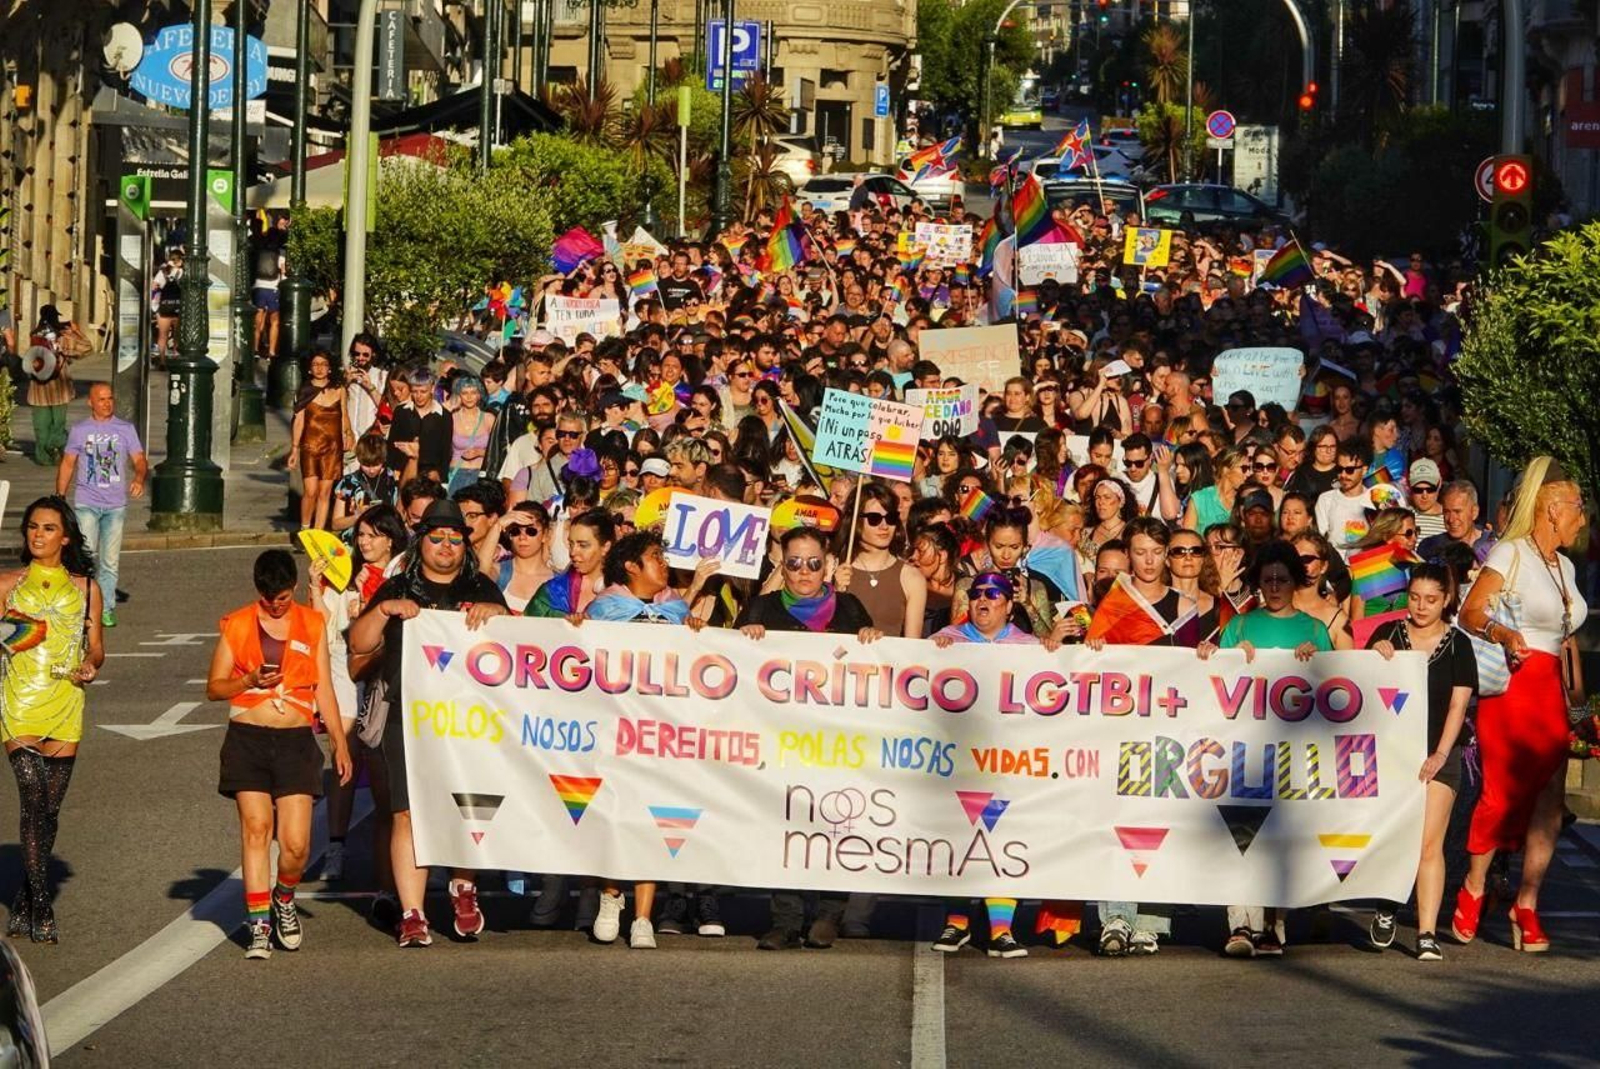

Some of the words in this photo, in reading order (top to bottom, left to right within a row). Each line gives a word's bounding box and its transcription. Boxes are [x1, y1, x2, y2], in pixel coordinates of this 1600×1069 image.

[718, 27, 751, 66] P
[826, 440, 873, 465] ATRÁS!
[842, 426, 856, 438] un
[856, 428, 882, 441] paso
[666, 503, 767, 566] LOVE
[465, 640, 738, 701] ORGULLO
[756, 645, 980, 714] CRÍTICO
[998, 670, 1189, 719] LGTBI+
[1208, 674, 1364, 723] VIGO
[411, 699, 504, 743] POLOS
[521, 713, 598, 753] NOSOS
[614, 717, 767, 771] DEREITOS,
[777, 730, 867, 769] POLAS
[881, 736, 956, 777] NOSAS
[1064, 748, 1100, 779] CON
[1116, 733, 1380, 801] ORGULLO
